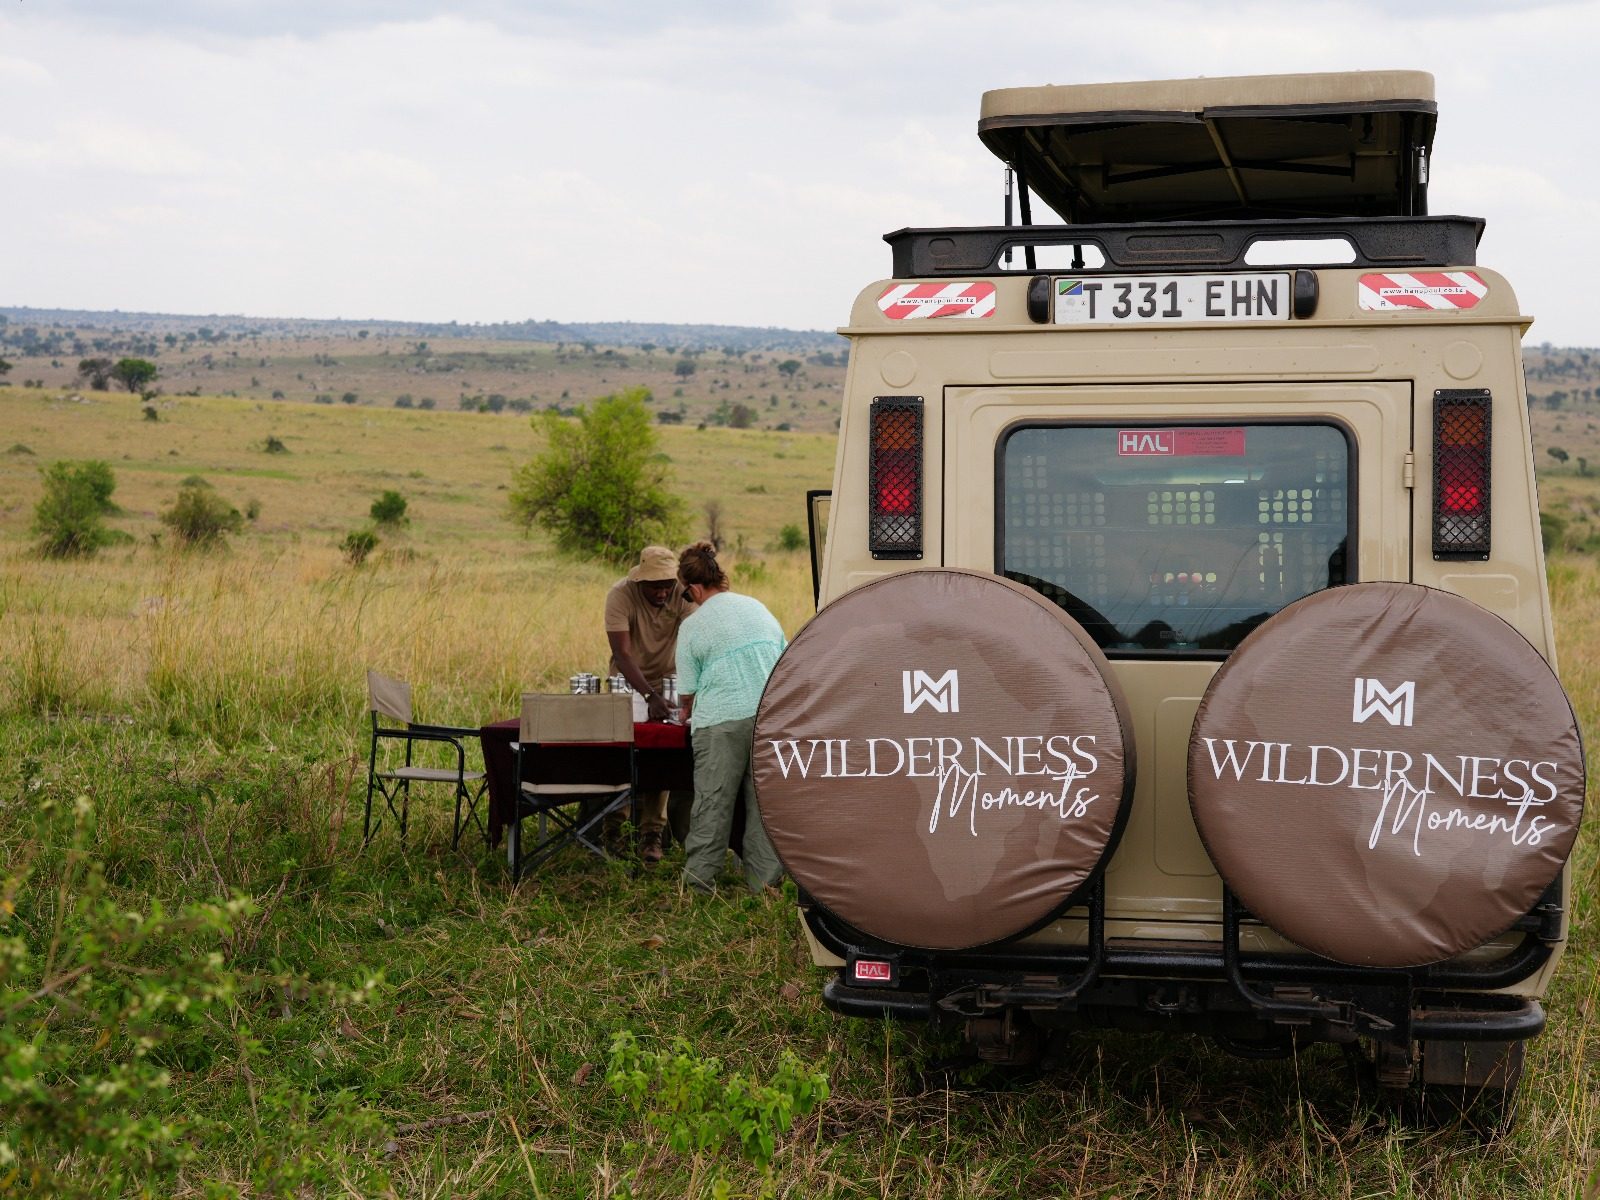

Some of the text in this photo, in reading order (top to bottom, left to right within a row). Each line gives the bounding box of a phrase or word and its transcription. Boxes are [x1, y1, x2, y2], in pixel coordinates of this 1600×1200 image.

[1083, 279, 1278, 319] T 331 EHN
[1122, 434, 1169, 452] HAL
[769, 735, 1098, 780] WILDERNESS
[1202, 737, 1558, 803] WILDERNESS
[929, 763, 1099, 836] Moments
[1368, 778, 1556, 856] Moments
[859, 964, 886, 976] HAL
